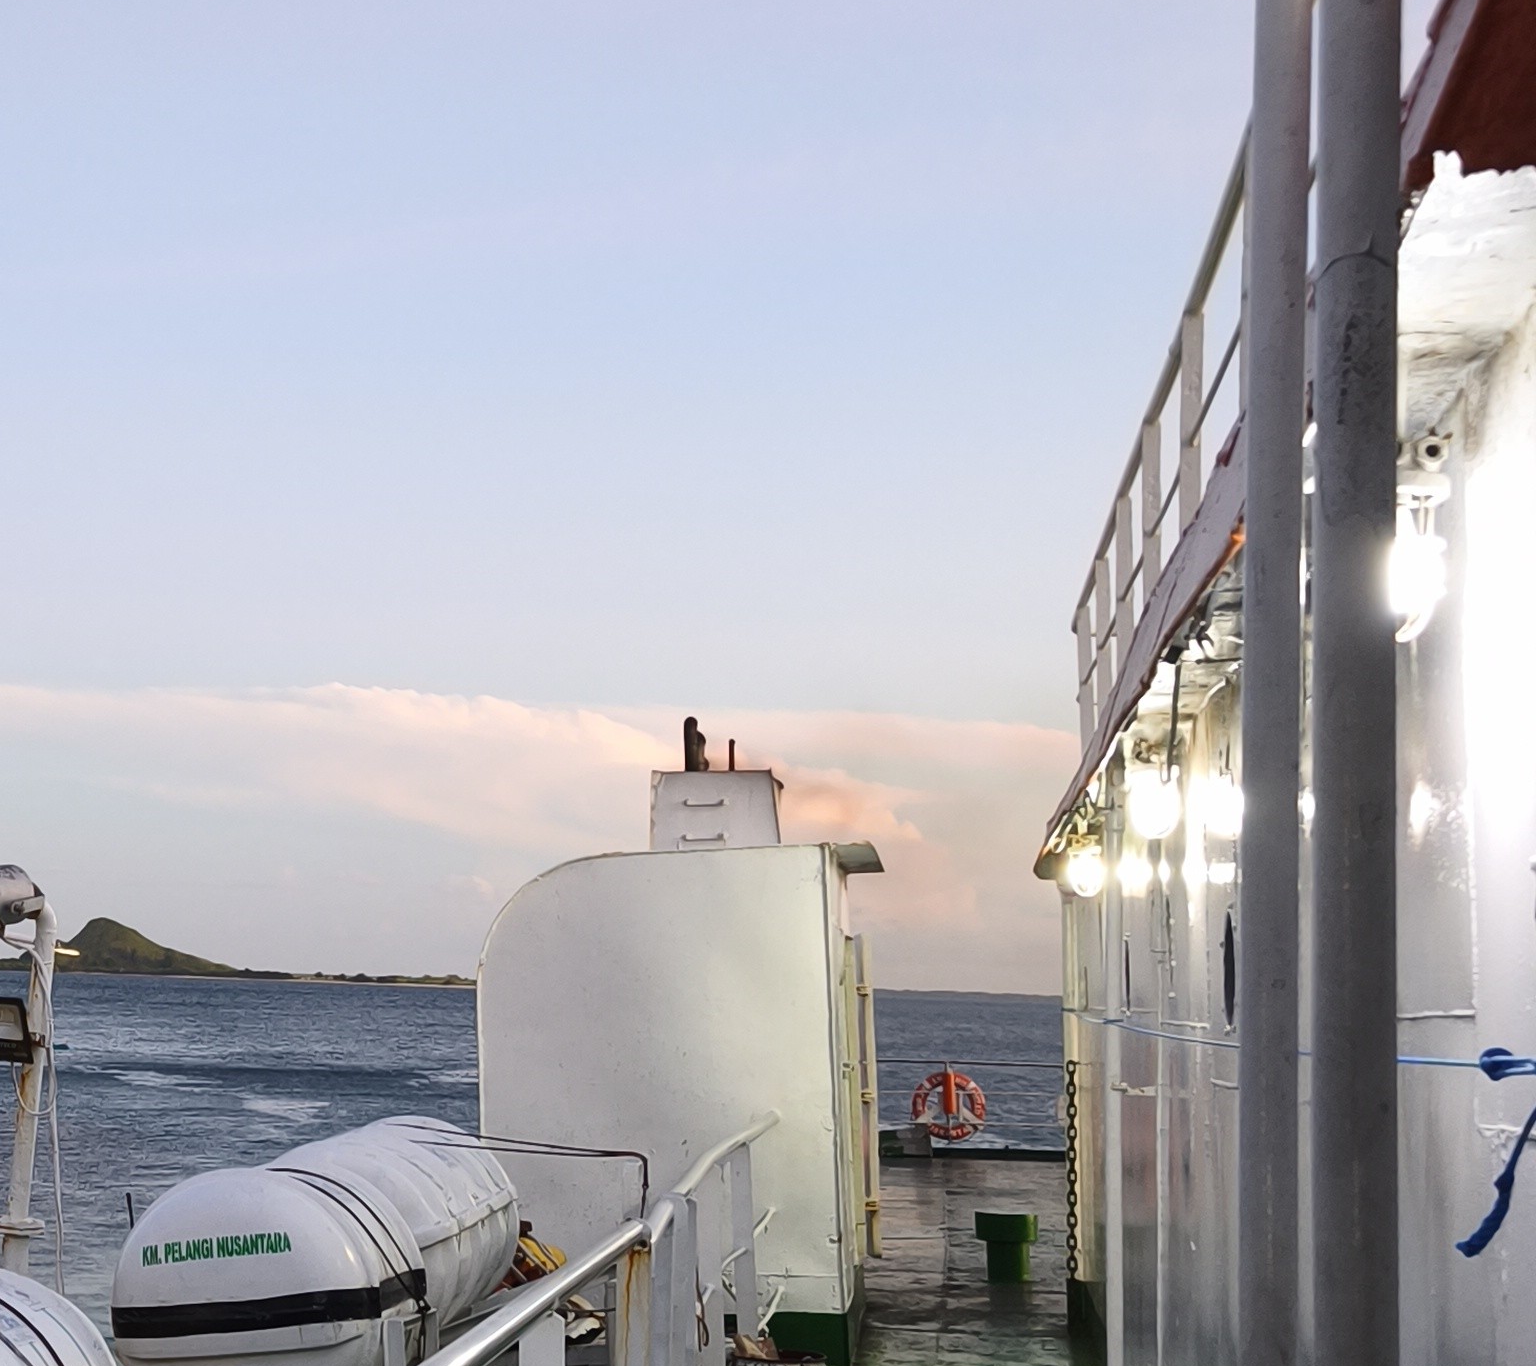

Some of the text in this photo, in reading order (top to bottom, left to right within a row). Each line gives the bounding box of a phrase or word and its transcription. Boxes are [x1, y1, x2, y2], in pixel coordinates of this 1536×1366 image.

[142, 1232, 292, 1267] KM. PELANGI NUSANTARA
